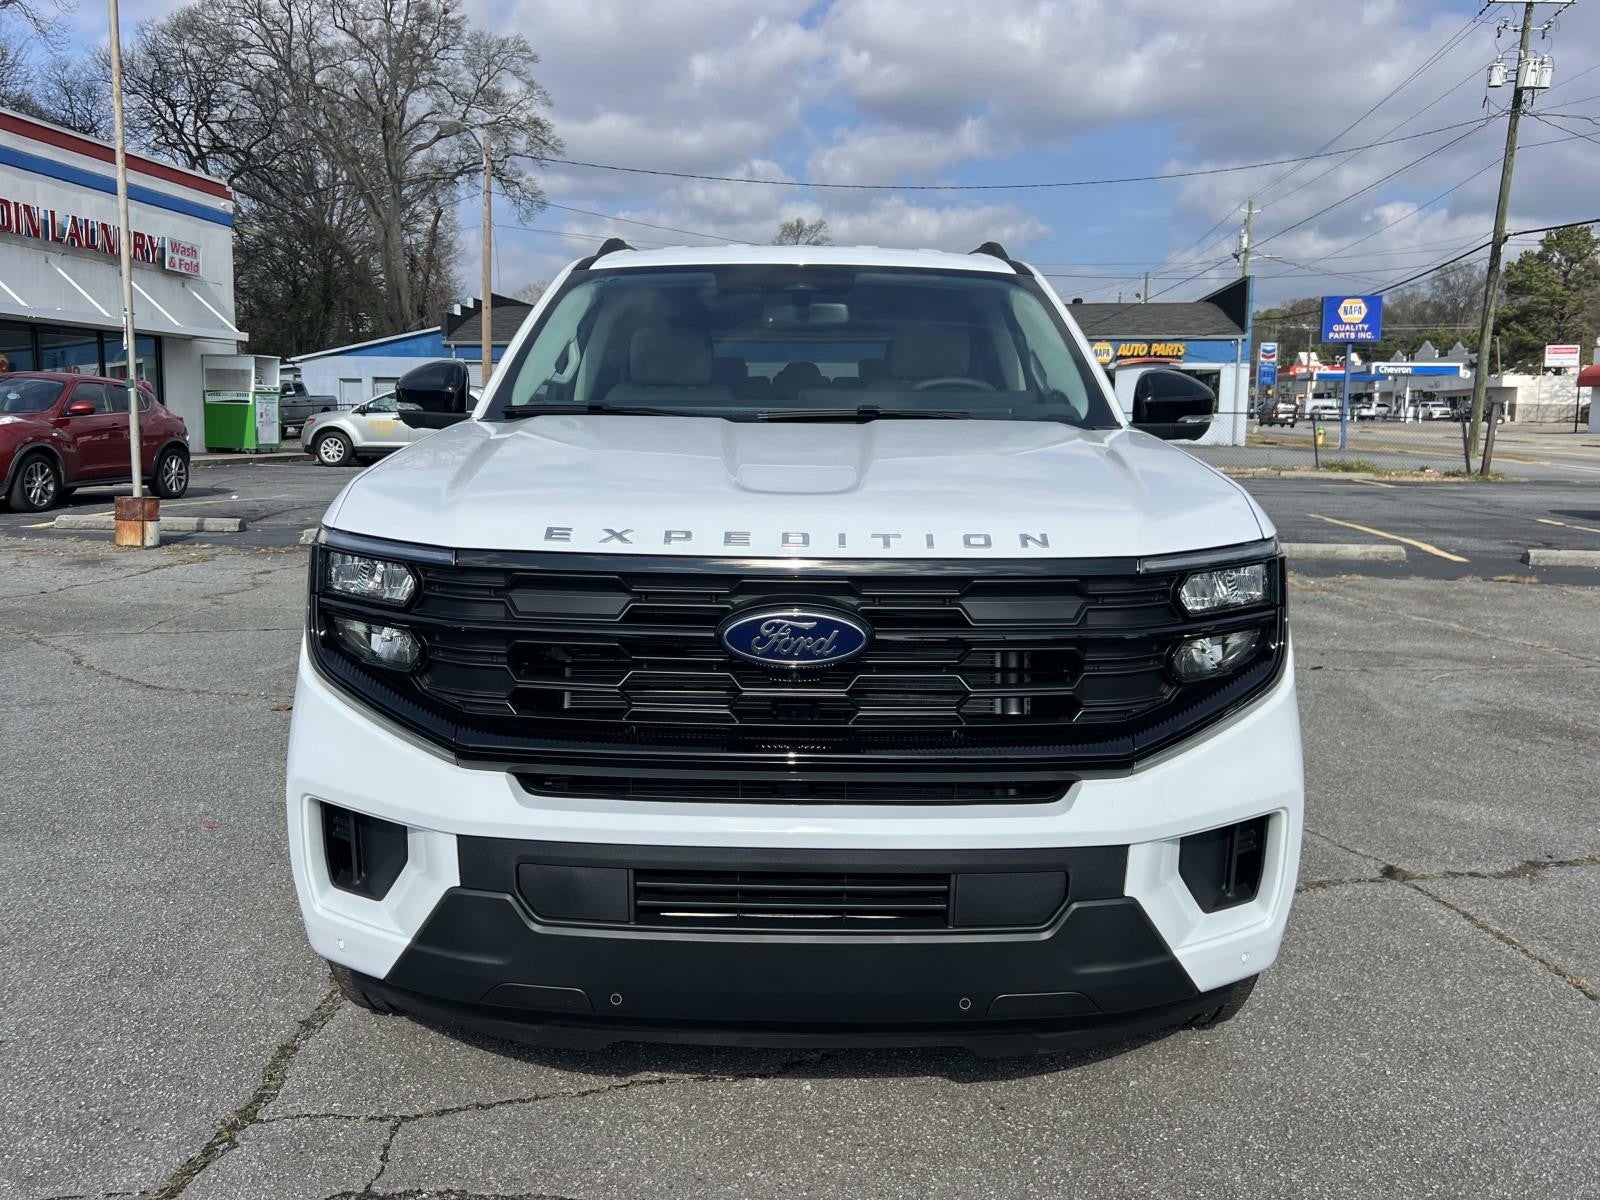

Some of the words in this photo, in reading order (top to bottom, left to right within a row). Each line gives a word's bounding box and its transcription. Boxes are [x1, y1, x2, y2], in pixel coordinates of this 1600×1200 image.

[49, 210, 160, 265] LAUNRY
[169, 240, 197, 258] Wash
[168, 257, 177, 268] &
[178, 260, 200, 273] Fold
[1343, 305, 1362, 316] NAPA
[1332, 324, 1369, 332] QUALITY
[1328, 332, 1355, 340] PARTS
[1357, 332, 1375, 340] INC.
[1117, 343, 1148, 356] AUTO
[1150, 343, 1185, 356] PARTS
[1378, 366, 1412, 374] Chevron
[543, 526, 1051, 549] EXPEDITION
[750, 618, 837, 659] Ford
